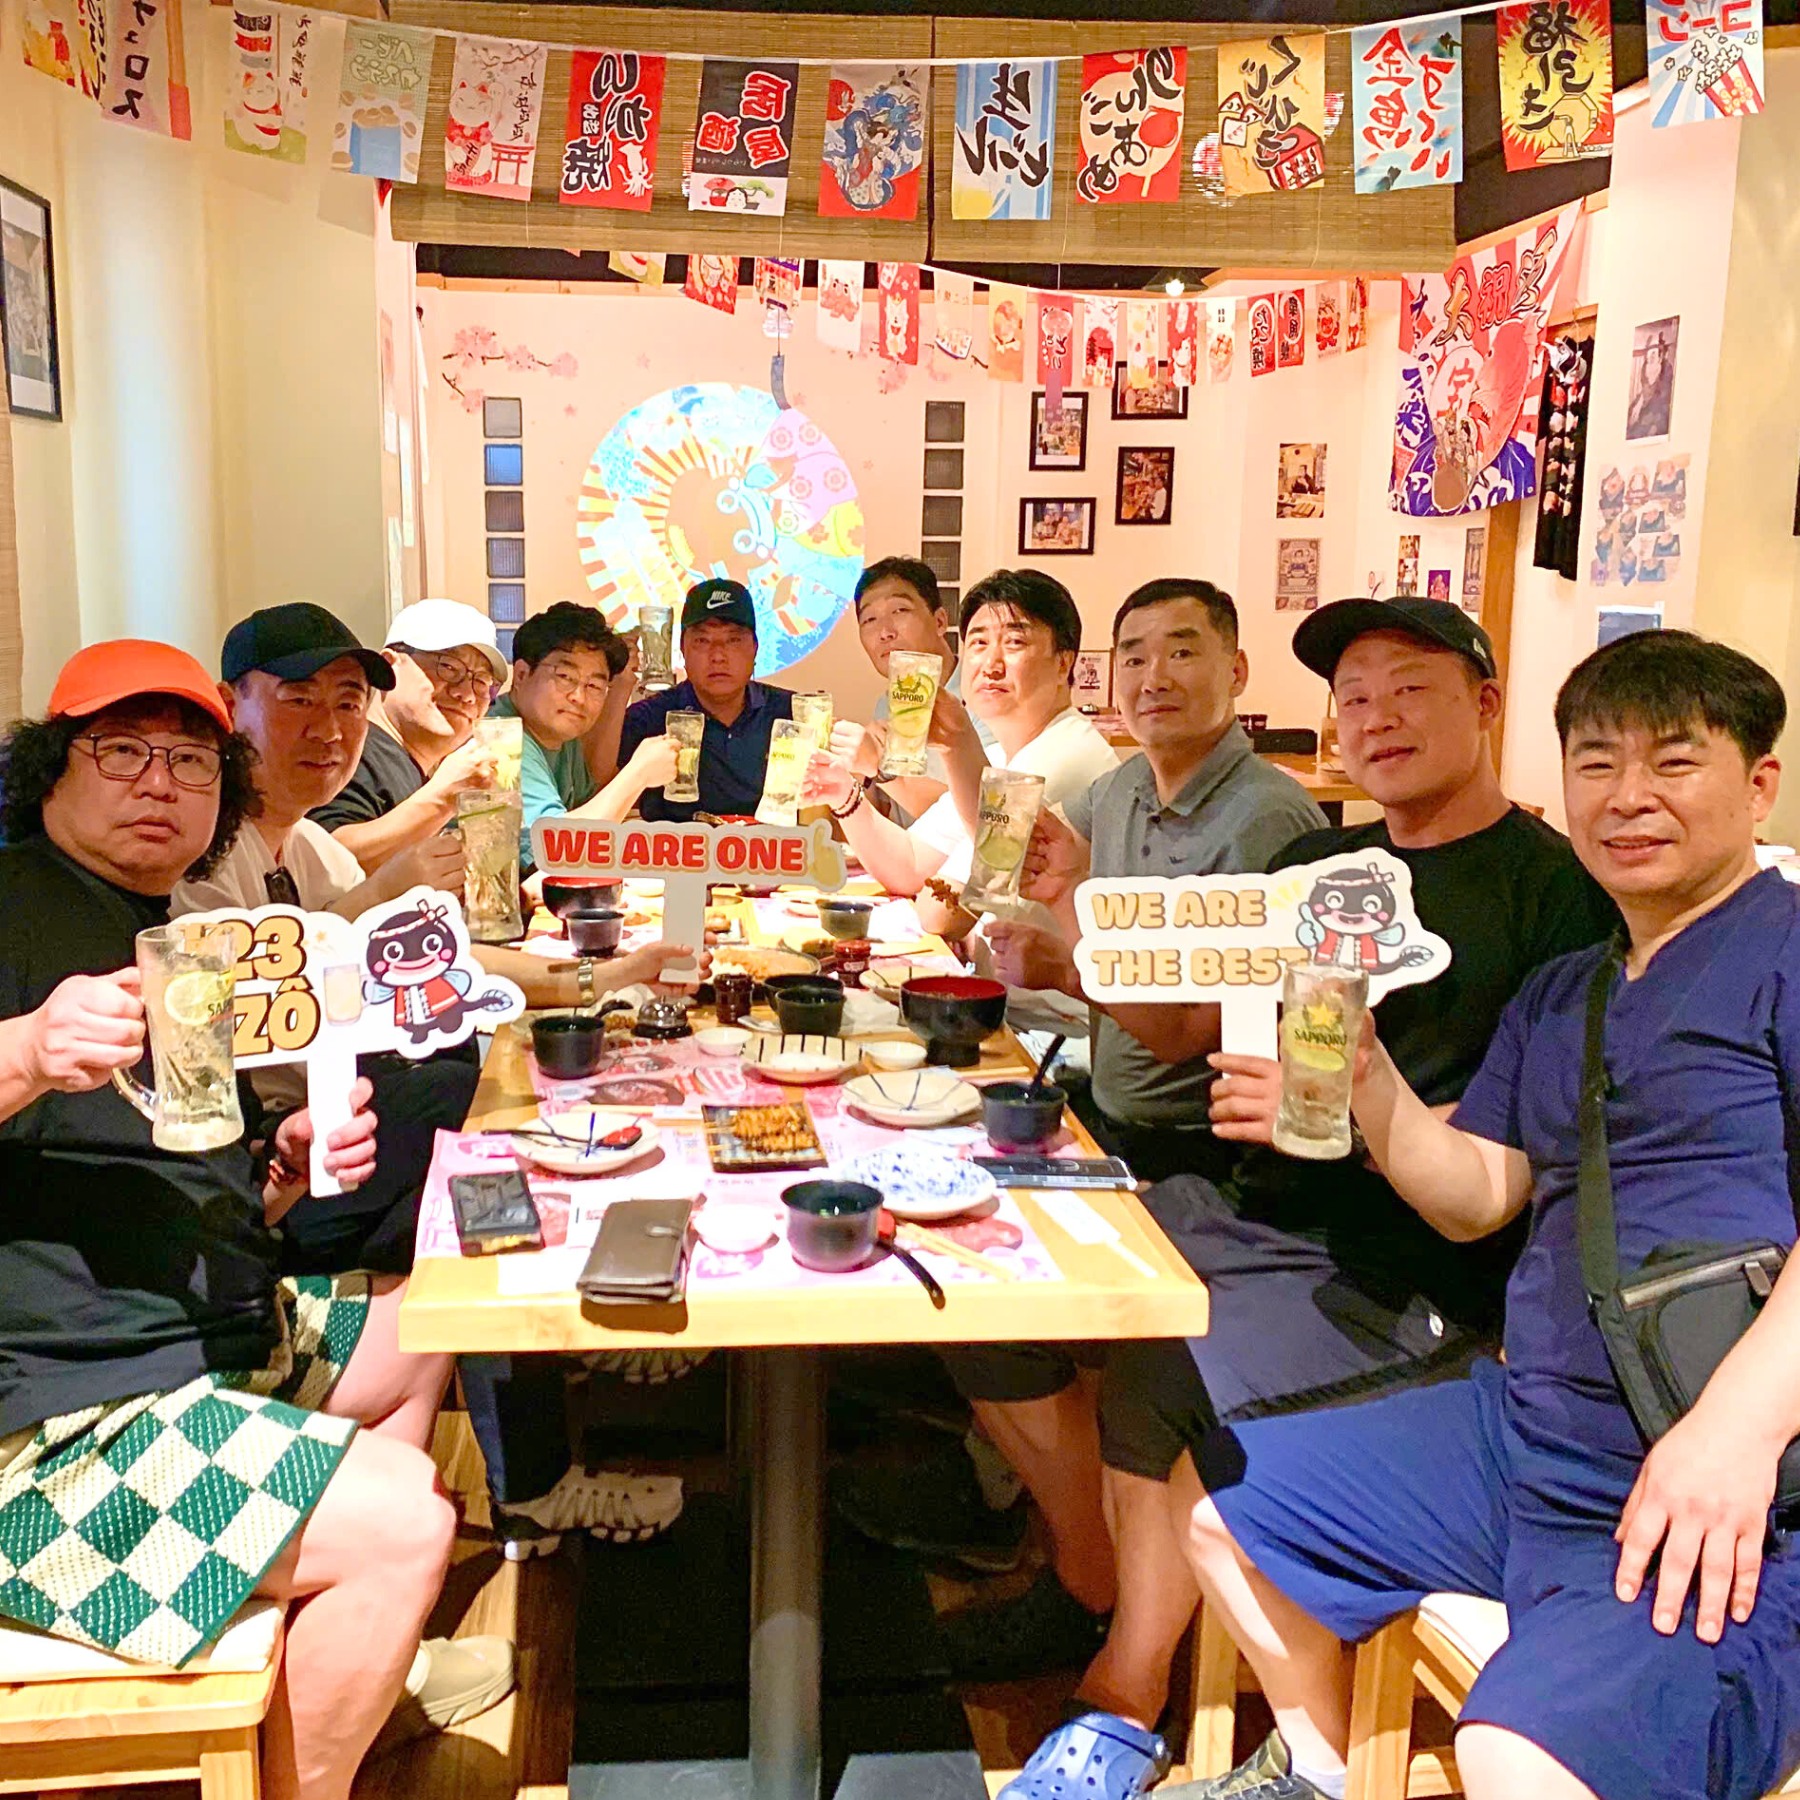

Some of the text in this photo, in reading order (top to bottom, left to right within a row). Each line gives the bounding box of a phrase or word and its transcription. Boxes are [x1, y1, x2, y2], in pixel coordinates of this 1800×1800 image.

[710, 590, 732, 601] NIKE
[892, 690, 924, 703] SAPPORO
[543, 829, 803, 871] WE ARE ONE
[1091, 889, 1267, 930] WE ARE
[1091, 946, 1313, 986] THE BEST
